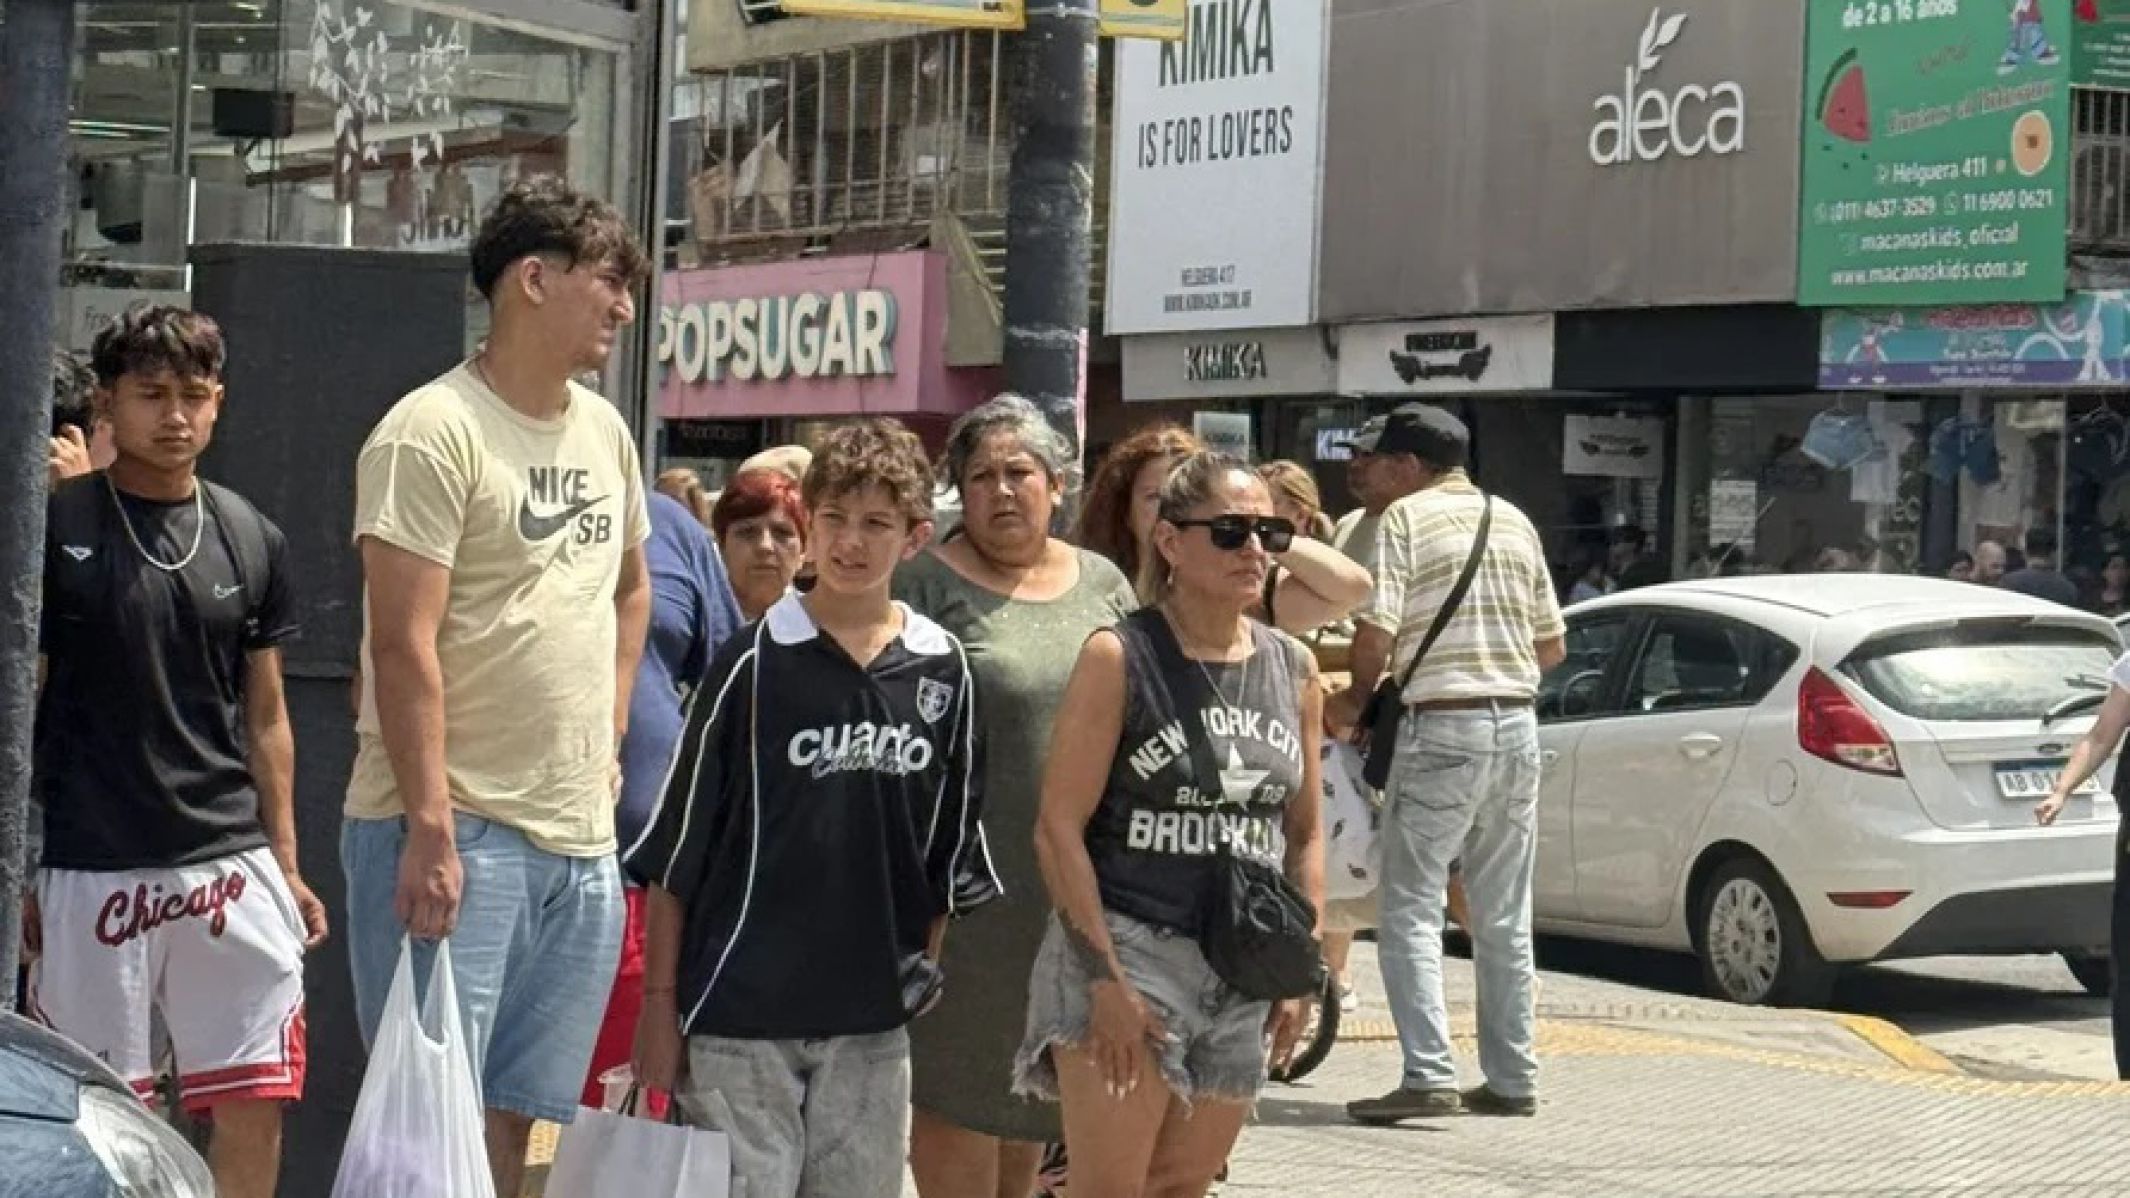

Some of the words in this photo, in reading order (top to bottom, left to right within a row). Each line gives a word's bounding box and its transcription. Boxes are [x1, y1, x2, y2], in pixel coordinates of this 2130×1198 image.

[1867, 2, 1877, 25] 2
[1138, 121, 1158, 169] IS
[1162, 116, 1201, 166] FOR
[1207, 104, 1293, 161] LOVERS
[1589, 66, 1744, 166] aleca
[1892, 163, 1959, 186] Helguera
[1962, 157, 1987, 177] 411
[658, 288, 897, 385] POPSUGAR
[1183, 342, 1267, 381] KIMIKA
[528, 466, 589, 505] NIKE
[577, 514, 611, 544] SB
[1129, 719, 1188, 780] NEW
[96, 871, 246, 946] Chicago
